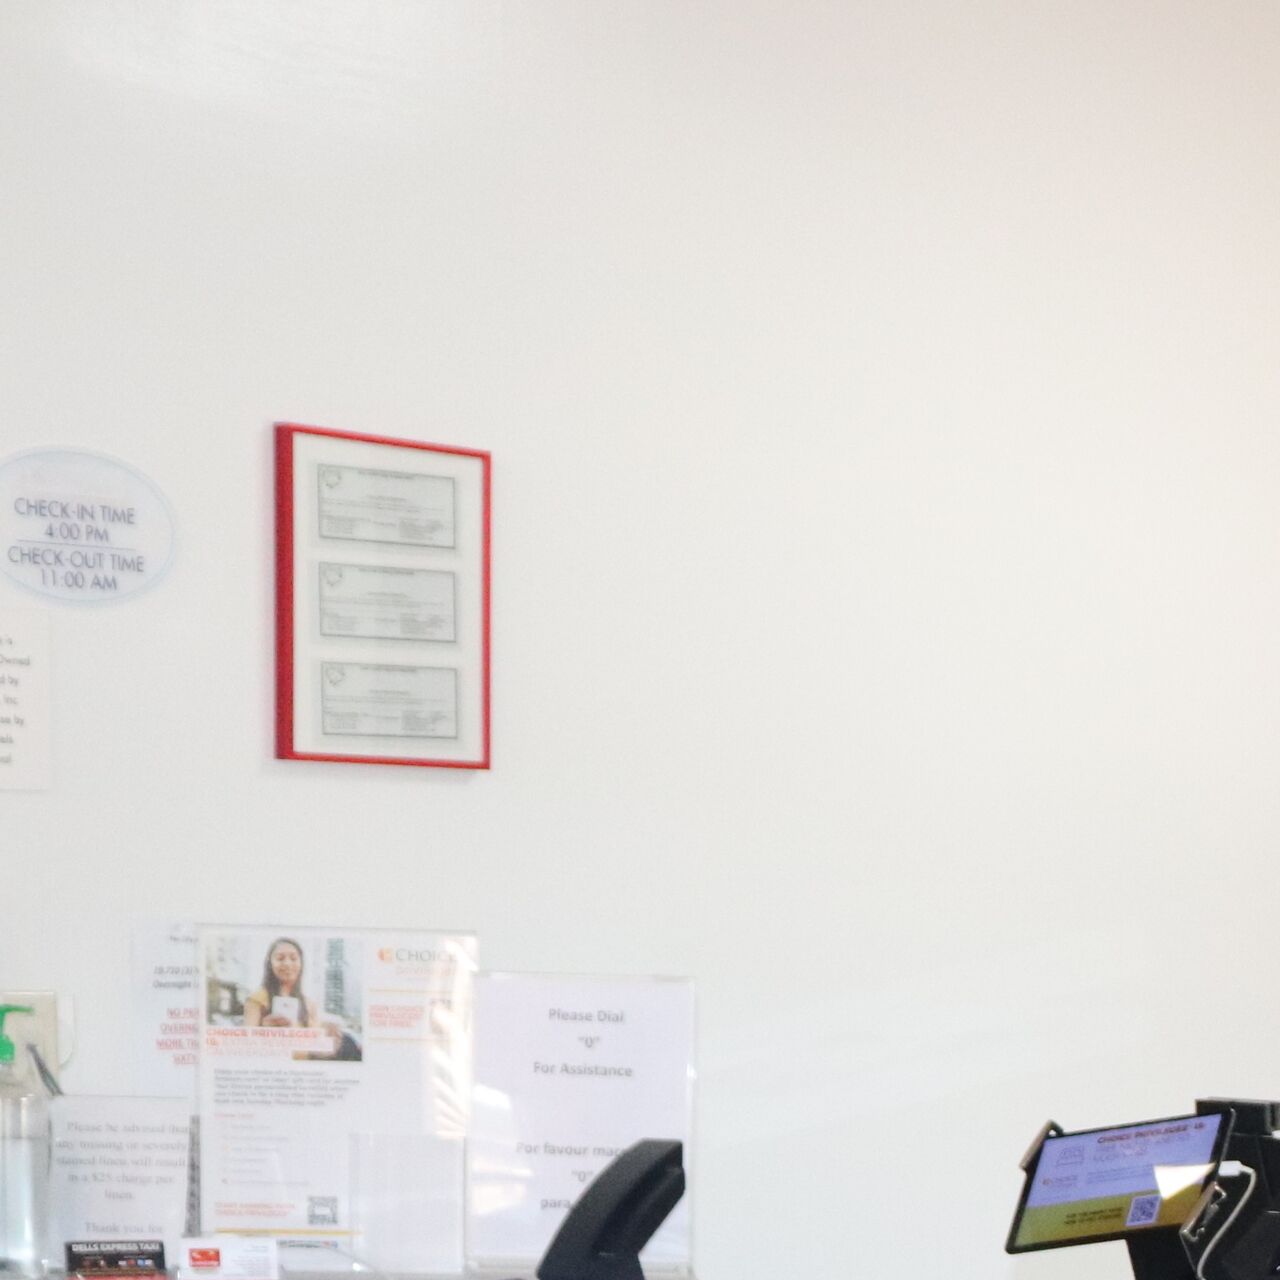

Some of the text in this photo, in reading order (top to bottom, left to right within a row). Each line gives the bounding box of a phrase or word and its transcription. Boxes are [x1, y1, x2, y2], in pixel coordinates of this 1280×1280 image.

[14, 497, 136, 525] CHECK-IN TIME
[45, 522, 109, 543] 4:00 PM
[7, 545, 145, 573] CHECK-OUT TIME
[41, 568, 118, 591] 11:00 AM
[549, 1008, 625, 1024] Please Dial
[533, 1061, 633, 1078] For Assistance
